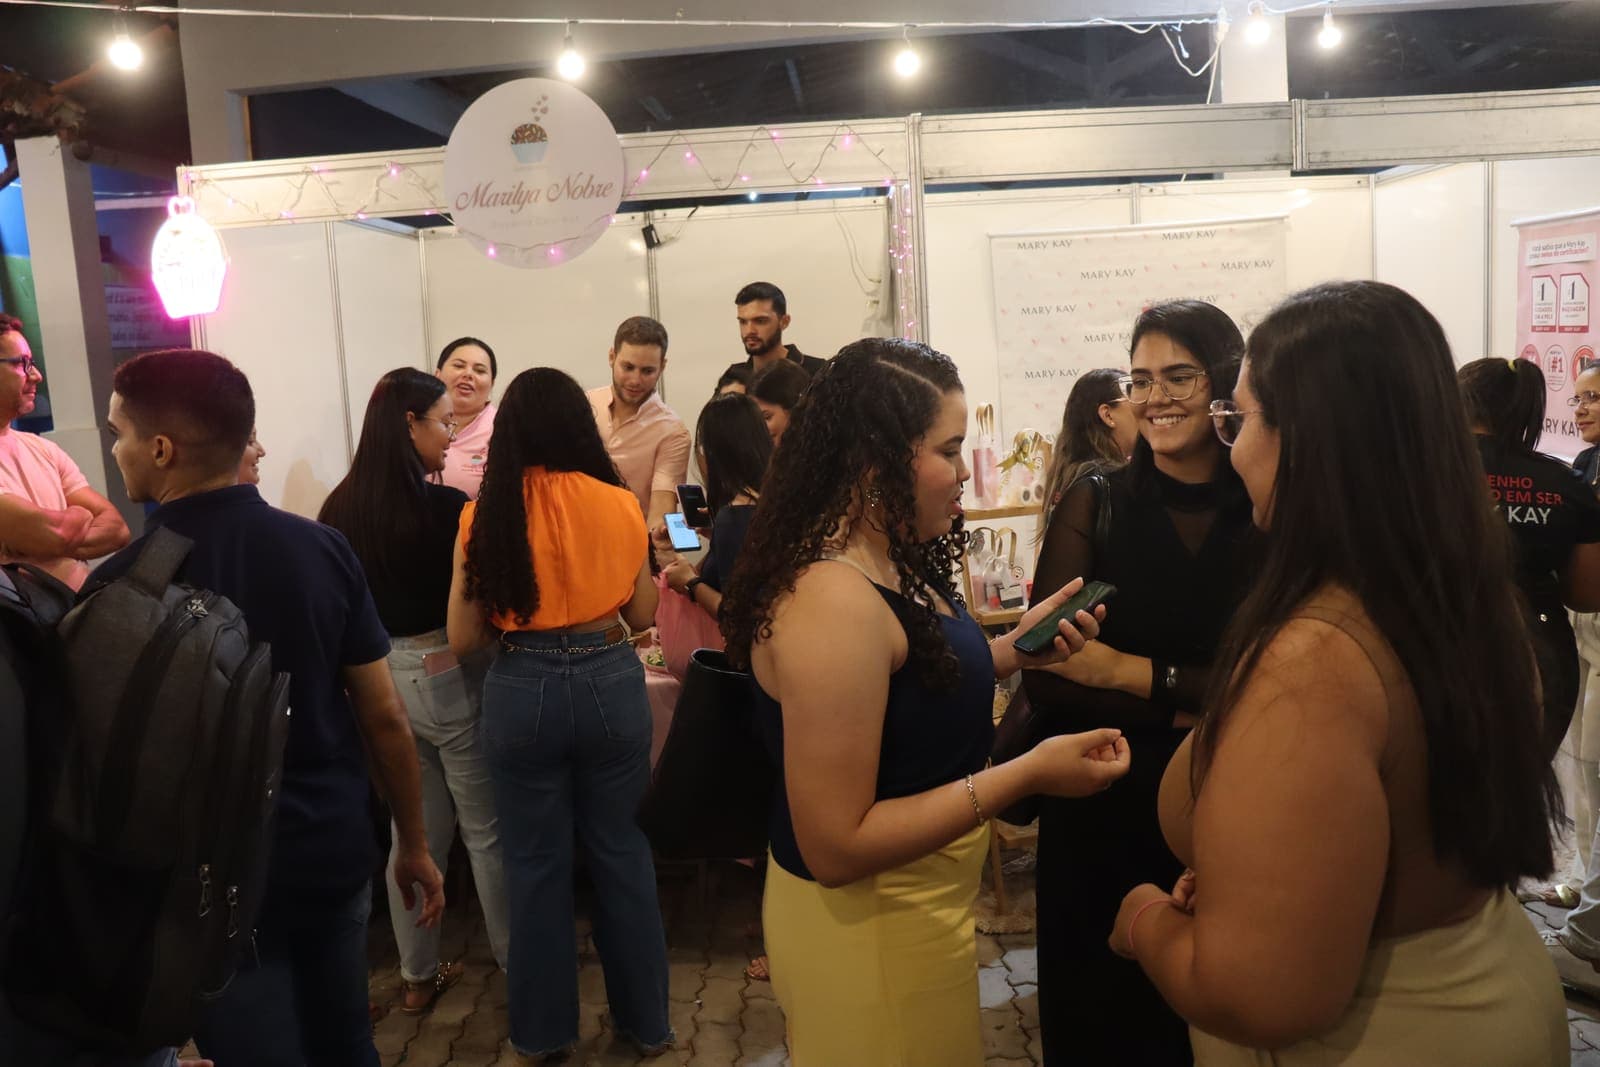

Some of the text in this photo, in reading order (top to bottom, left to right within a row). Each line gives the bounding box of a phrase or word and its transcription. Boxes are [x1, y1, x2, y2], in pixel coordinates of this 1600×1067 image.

[455, 172, 614, 214] Marilya Nobre
[1162, 230, 1217, 241] MARY KAY
[1017, 239, 1073, 251] MARY KAY
[1220, 259, 1274, 271] MARY KAY
[1080, 268, 1136, 280] MARY KAY
[1021, 304, 1077, 316] MARY KAY
[1083, 331, 1132, 344] MARY KA
[1024, 368, 1081, 380] MARY KAY
[1543, 418, 1559, 434] RY
[1487, 474, 1533, 489] ENHO
[1505, 490, 1531, 503] EM
[1536, 491, 1562, 504] SER
[1507, 505, 1551, 524] KAY
